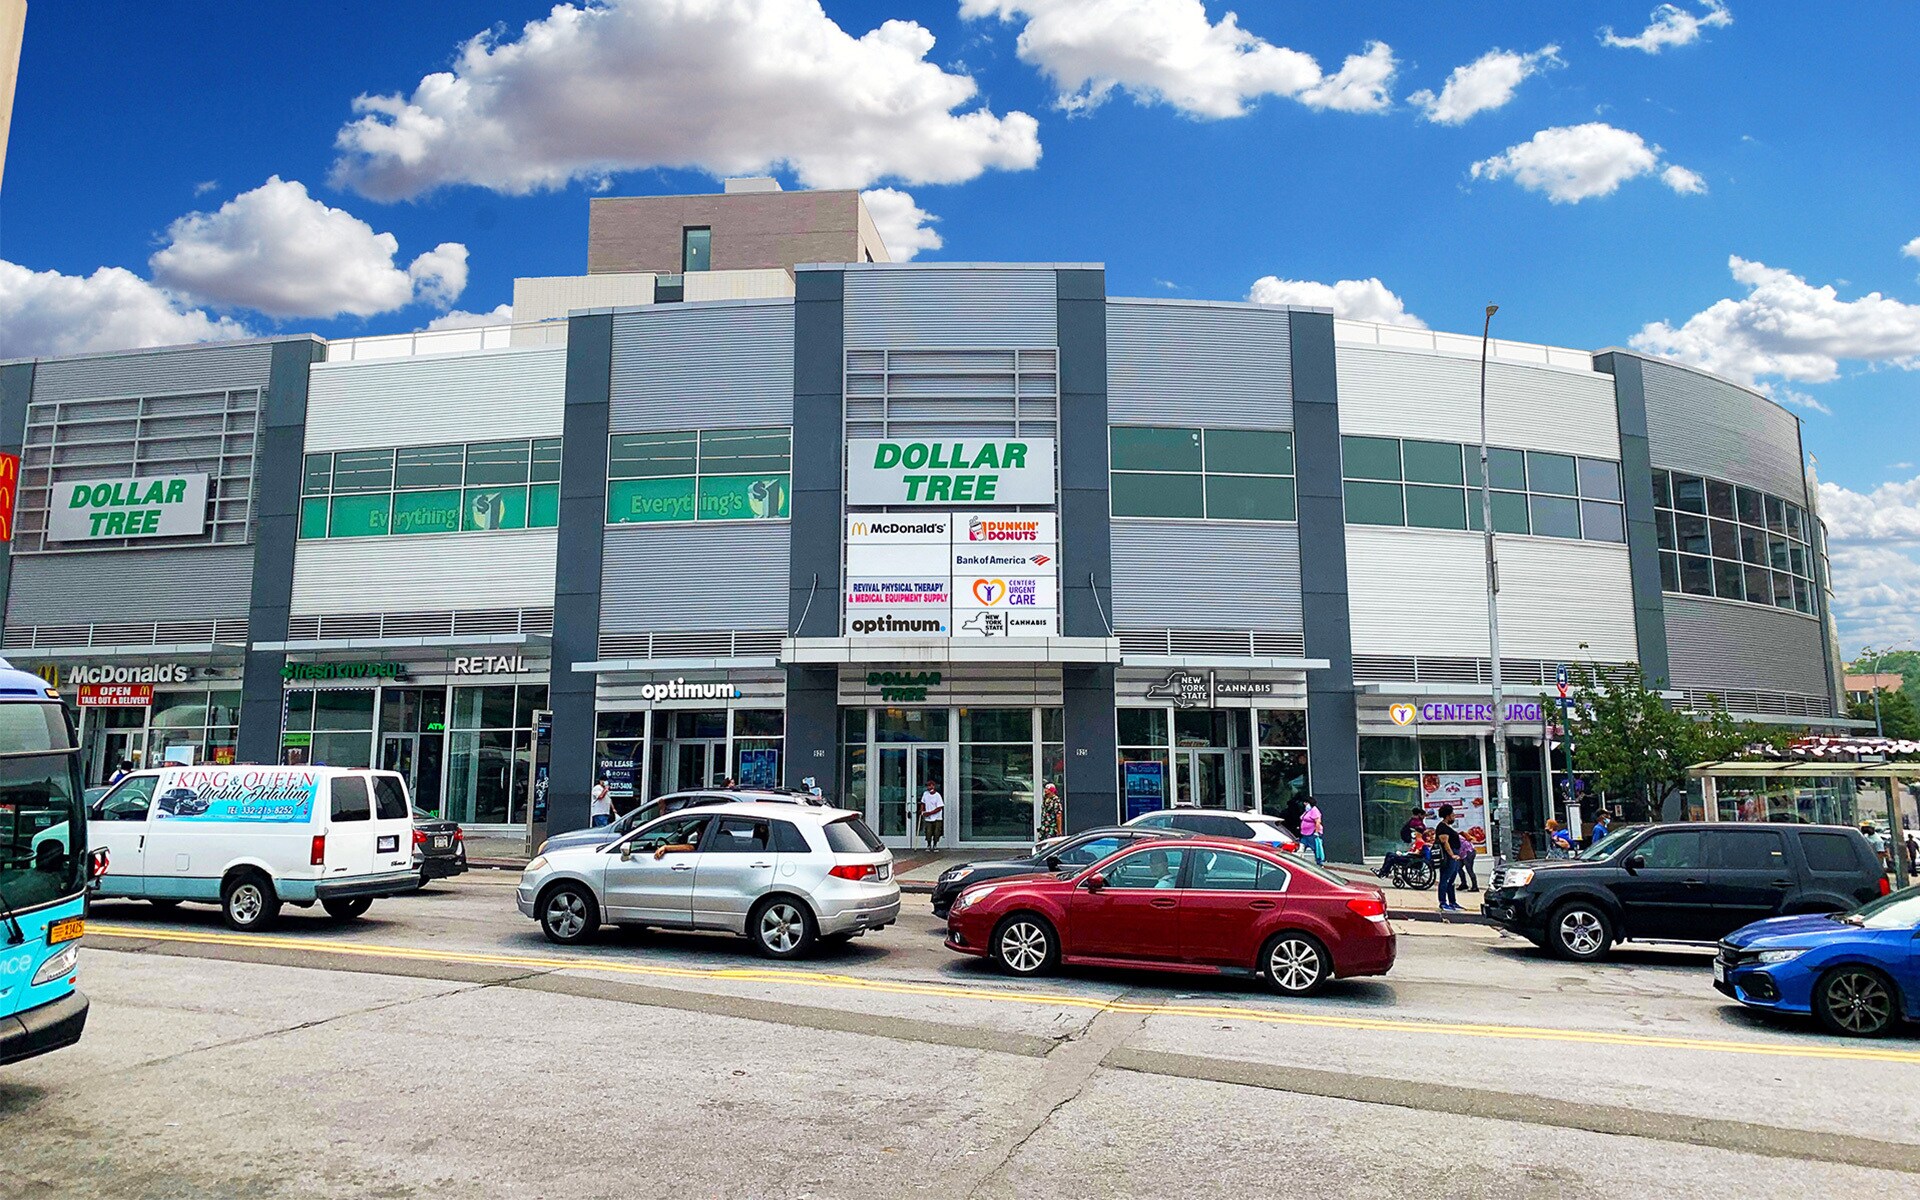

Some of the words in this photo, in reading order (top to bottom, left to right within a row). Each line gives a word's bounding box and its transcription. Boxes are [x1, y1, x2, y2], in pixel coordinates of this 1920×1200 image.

[874, 443, 1028, 469] DOLLAR
[903, 475, 999, 501] TREE
[68, 479, 187, 509] DOLLAR
[89, 510, 162, 536] TREE
[870, 523, 944, 534] McDonald's
[988, 521, 1039, 531] DUNKIN'
[988, 531, 1037, 541] DONUTS
[956, 555, 979, 564] Bank
[979, 555, 989, 564] of
[990, 555, 1026, 564] America
[853, 583, 880, 592] REVIVAL
[881, 583, 913, 592] PHYSICAL
[914, 583, 944, 592] THERAPY
[1008, 586, 1036, 594] URGENT
[848, 594, 854, 602] &
[855, 594, 884, 602] MEDICAL
[885, 594, 922, 603] EQUIPMENT
[923, 594, 949, 602] SUPPLY
[1008, 594, 1036, 605] CARE
[337, 662, 367, 678] CITY
[454, 655, 529, 674] RETAIL
[68, 663, 188, 684] McDonald's
[867, 671, 942, 686] DOLLAR
[100, 686, 131, 696] OPEN
[1217, 684, 1271, 692] CANNABIS
[81, 696, 97, 704] TAKE
[98, 696, 111, 704] OUT
[118, 696, 150, 704] DELIVERY
[1422, 703, 1492, 721] CENTERS
[427, 722, 446, 730] ATM
[614, 760, 634, 768] LEASE
[177, 772, 229, 787] KING
[230, 776, 240, 786] &
[243, 771, 316, 790] QUEEN
[197, 783, 244, 801] Mobile
[243, 782, 311, 806] Detailing
